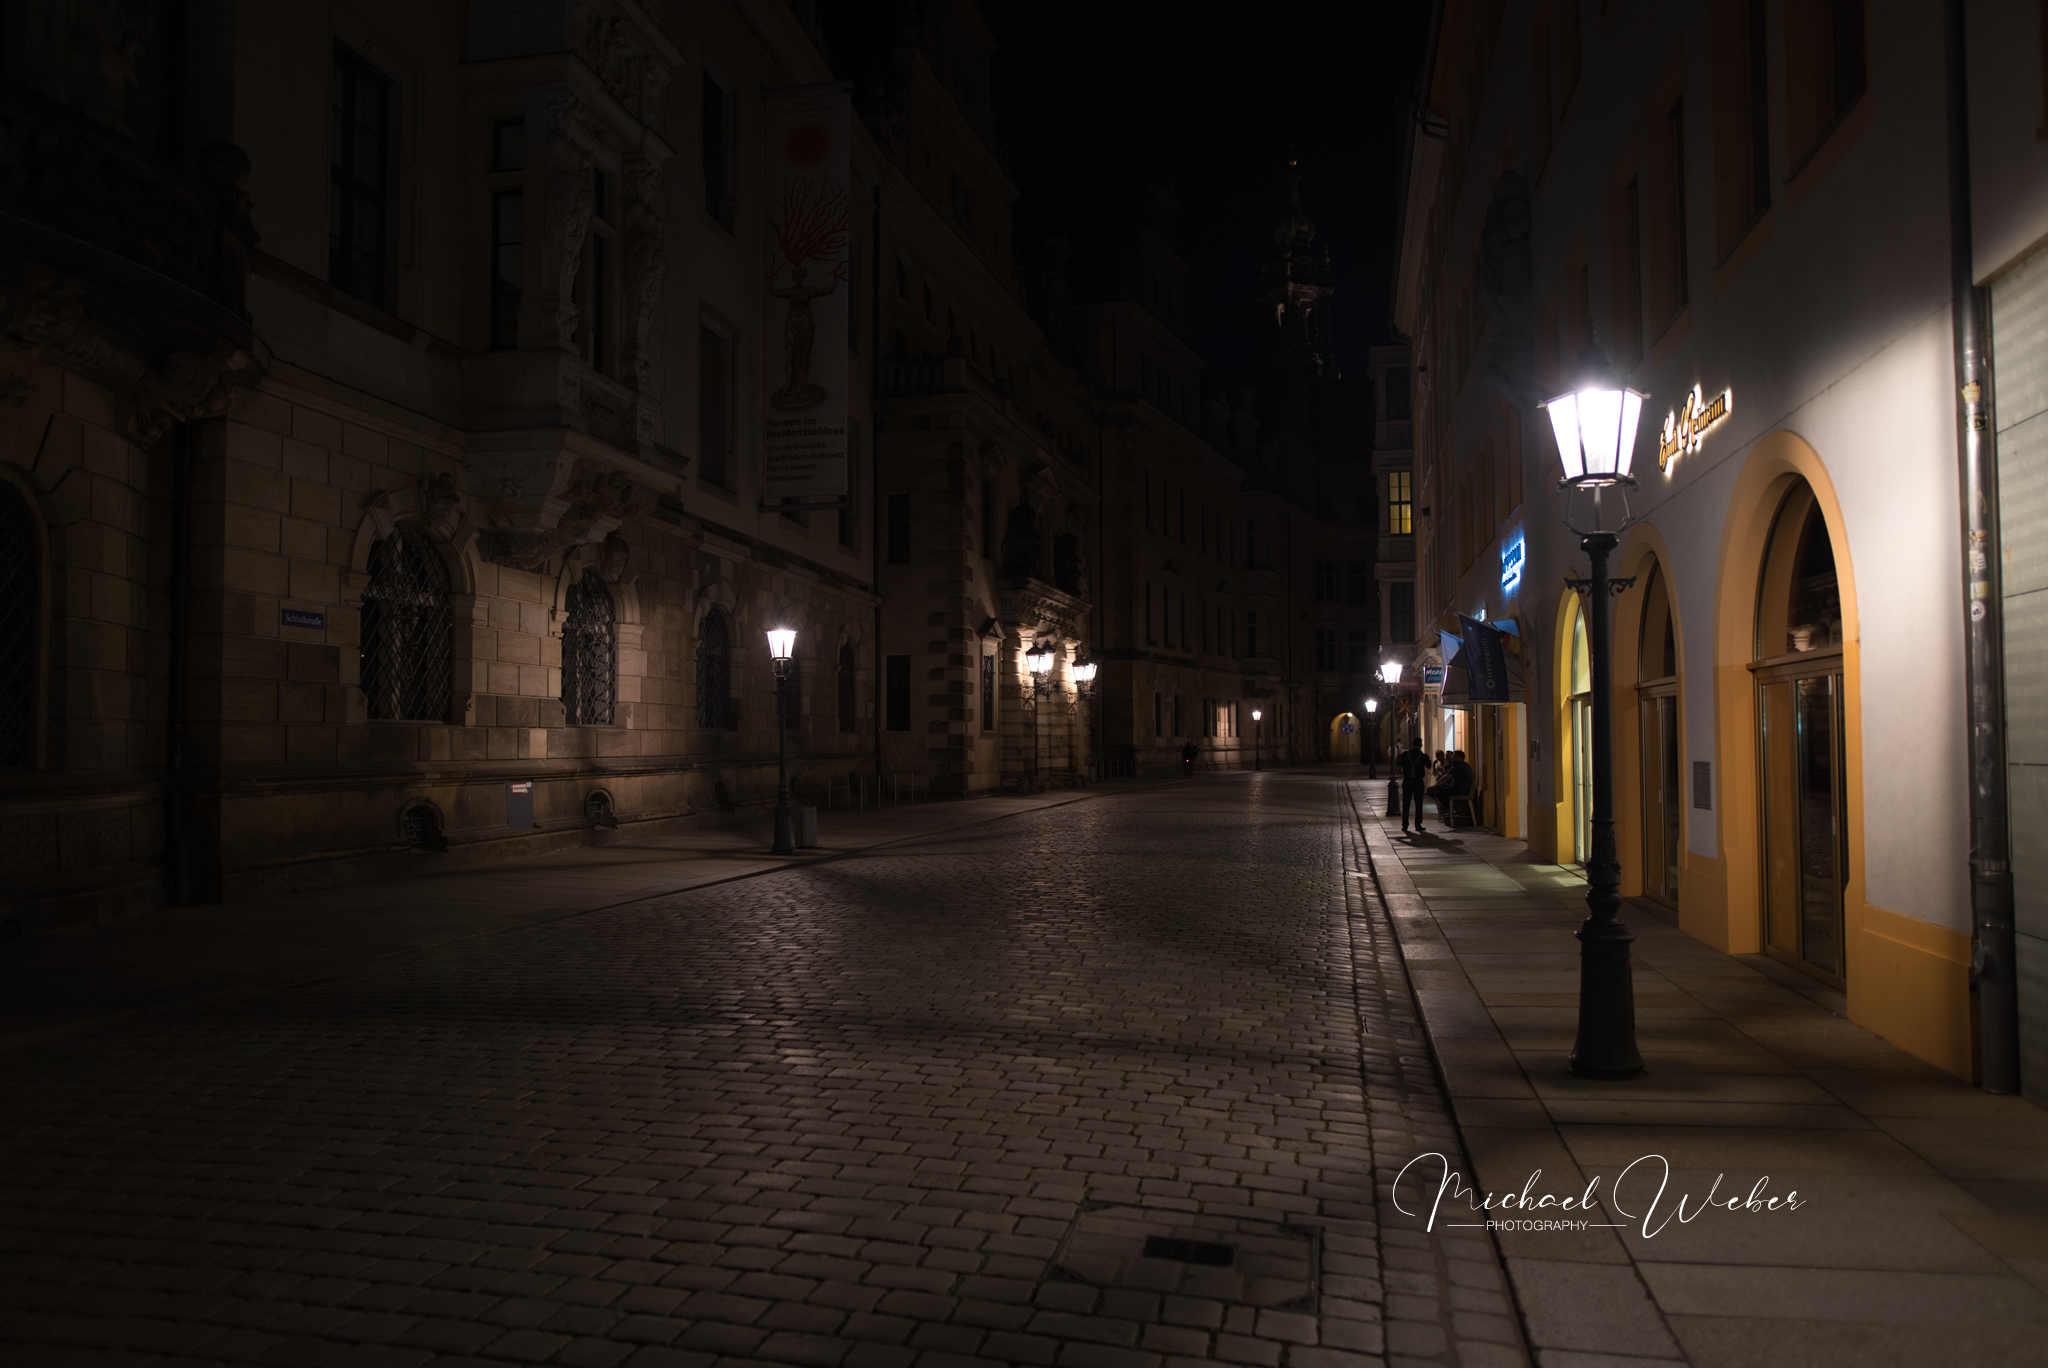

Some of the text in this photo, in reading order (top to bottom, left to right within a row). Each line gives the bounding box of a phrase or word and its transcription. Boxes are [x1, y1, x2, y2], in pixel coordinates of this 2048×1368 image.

[781, 105, 835, 114] Kunstsammlungen
[766, 417, 816, 428] Museen im
[766, 426, 844, 438] Residenzschloss
[766, 442, 826, 452] Grünes Gewölbe
[766, 452, 844, 463] Kupferstich-Kabinett
[766, 463, 816, 473] Münzkabinett
[766, 474, 813, 483] Rüstkammer
[285, 613, 322, 626] Schloßstraße
